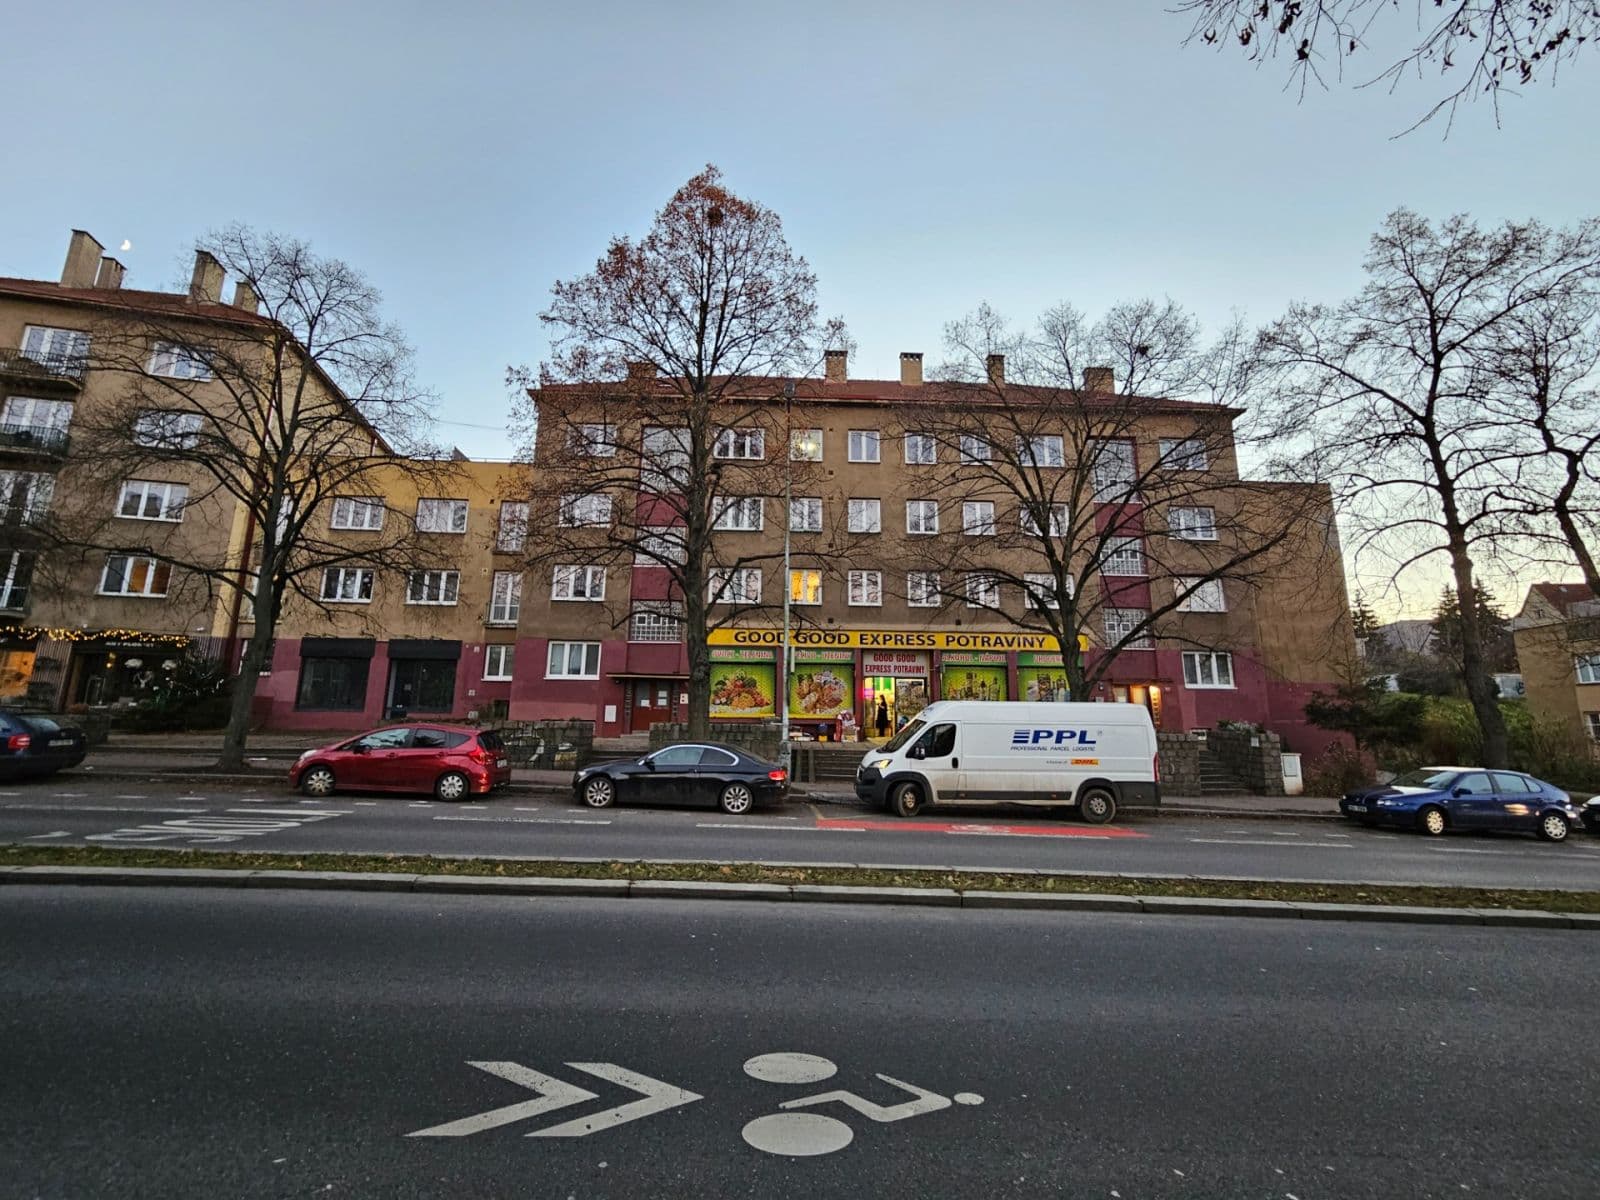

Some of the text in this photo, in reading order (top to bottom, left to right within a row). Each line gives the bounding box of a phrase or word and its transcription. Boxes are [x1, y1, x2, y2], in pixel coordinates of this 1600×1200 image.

[734, 631, 1046, 648] GOOD GOOD EXPRESS POTRAVINY
[873, 654, 894, 662] GOOD
[865, 665, 925, 674] EXPRESS POTRAVINY
[1031, 730, 1097, 744] PPL
